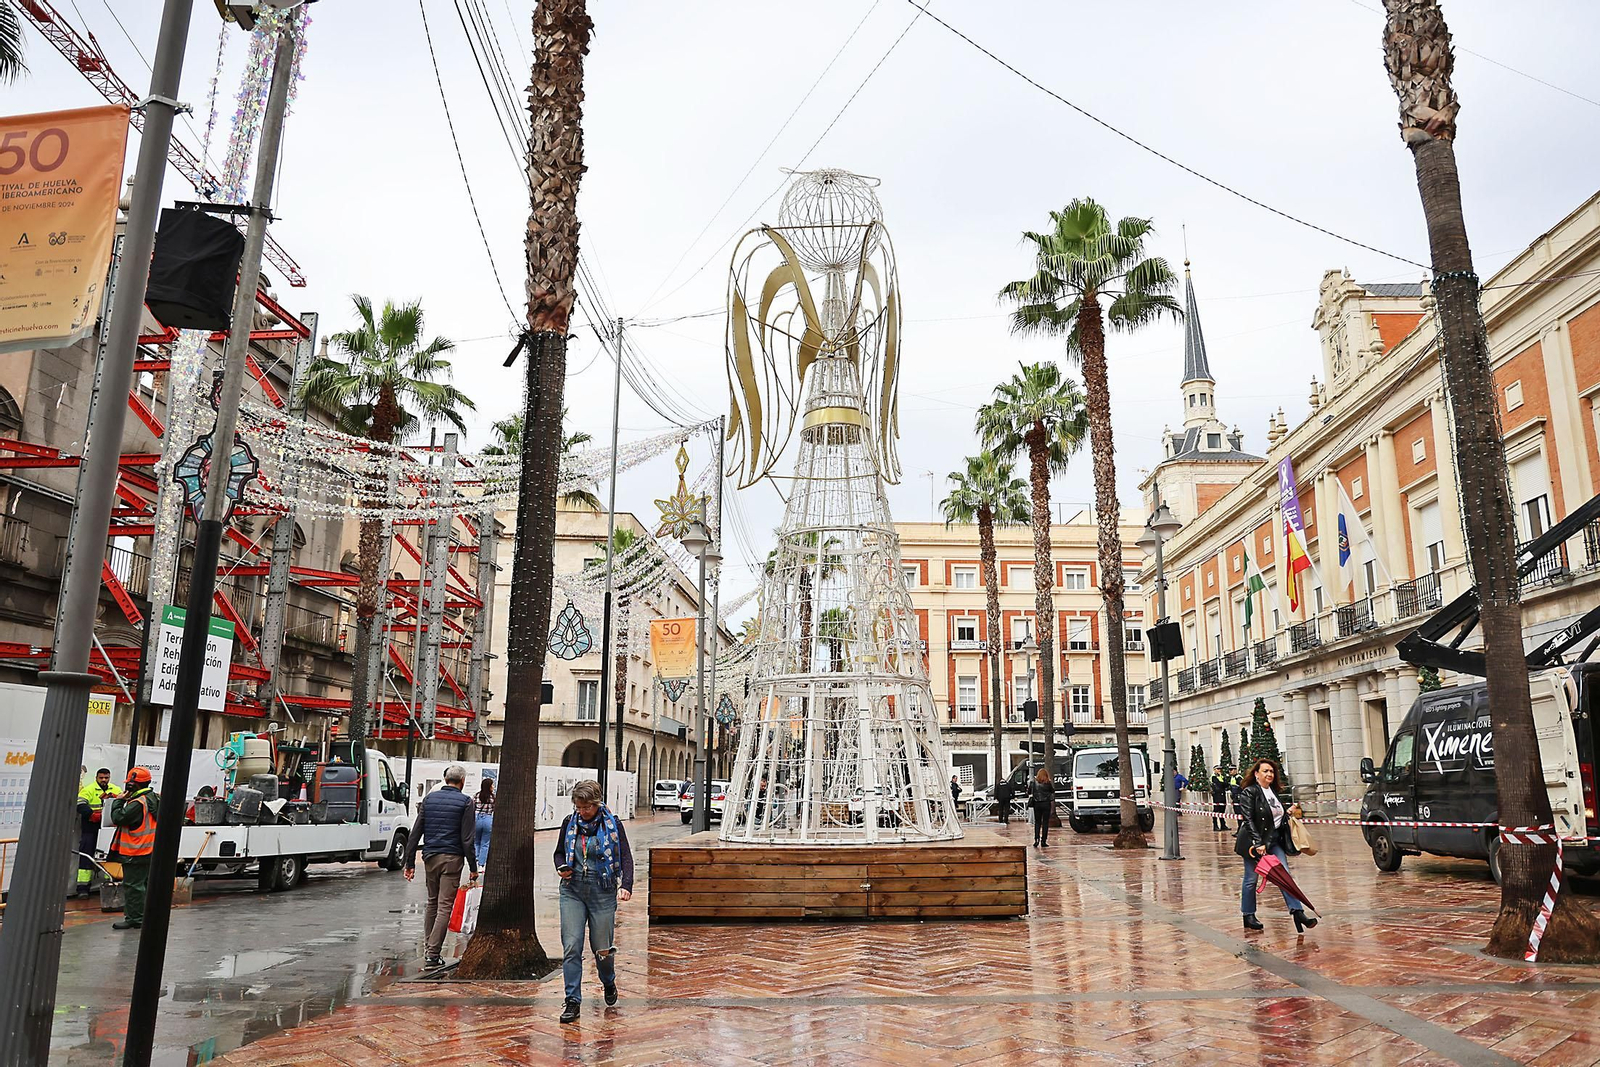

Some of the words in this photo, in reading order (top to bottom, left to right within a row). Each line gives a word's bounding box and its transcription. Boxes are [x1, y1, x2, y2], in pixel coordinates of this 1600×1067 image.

[0, 128, 69, 175] 50
[43, 179, 77, 188] HUELVA
[2, 186, 83, 199] IBEROAMERICANO
[13, 202, 56, 211] NOVIEMBRE
[662, 622, 681, 636] 50
[1337, 646, 1387, 667] AYUNTAMIENTO
[1447, 720, 1492, 732] ILUMINACIONE
[1425, 719, 1494, 775] Ximene
